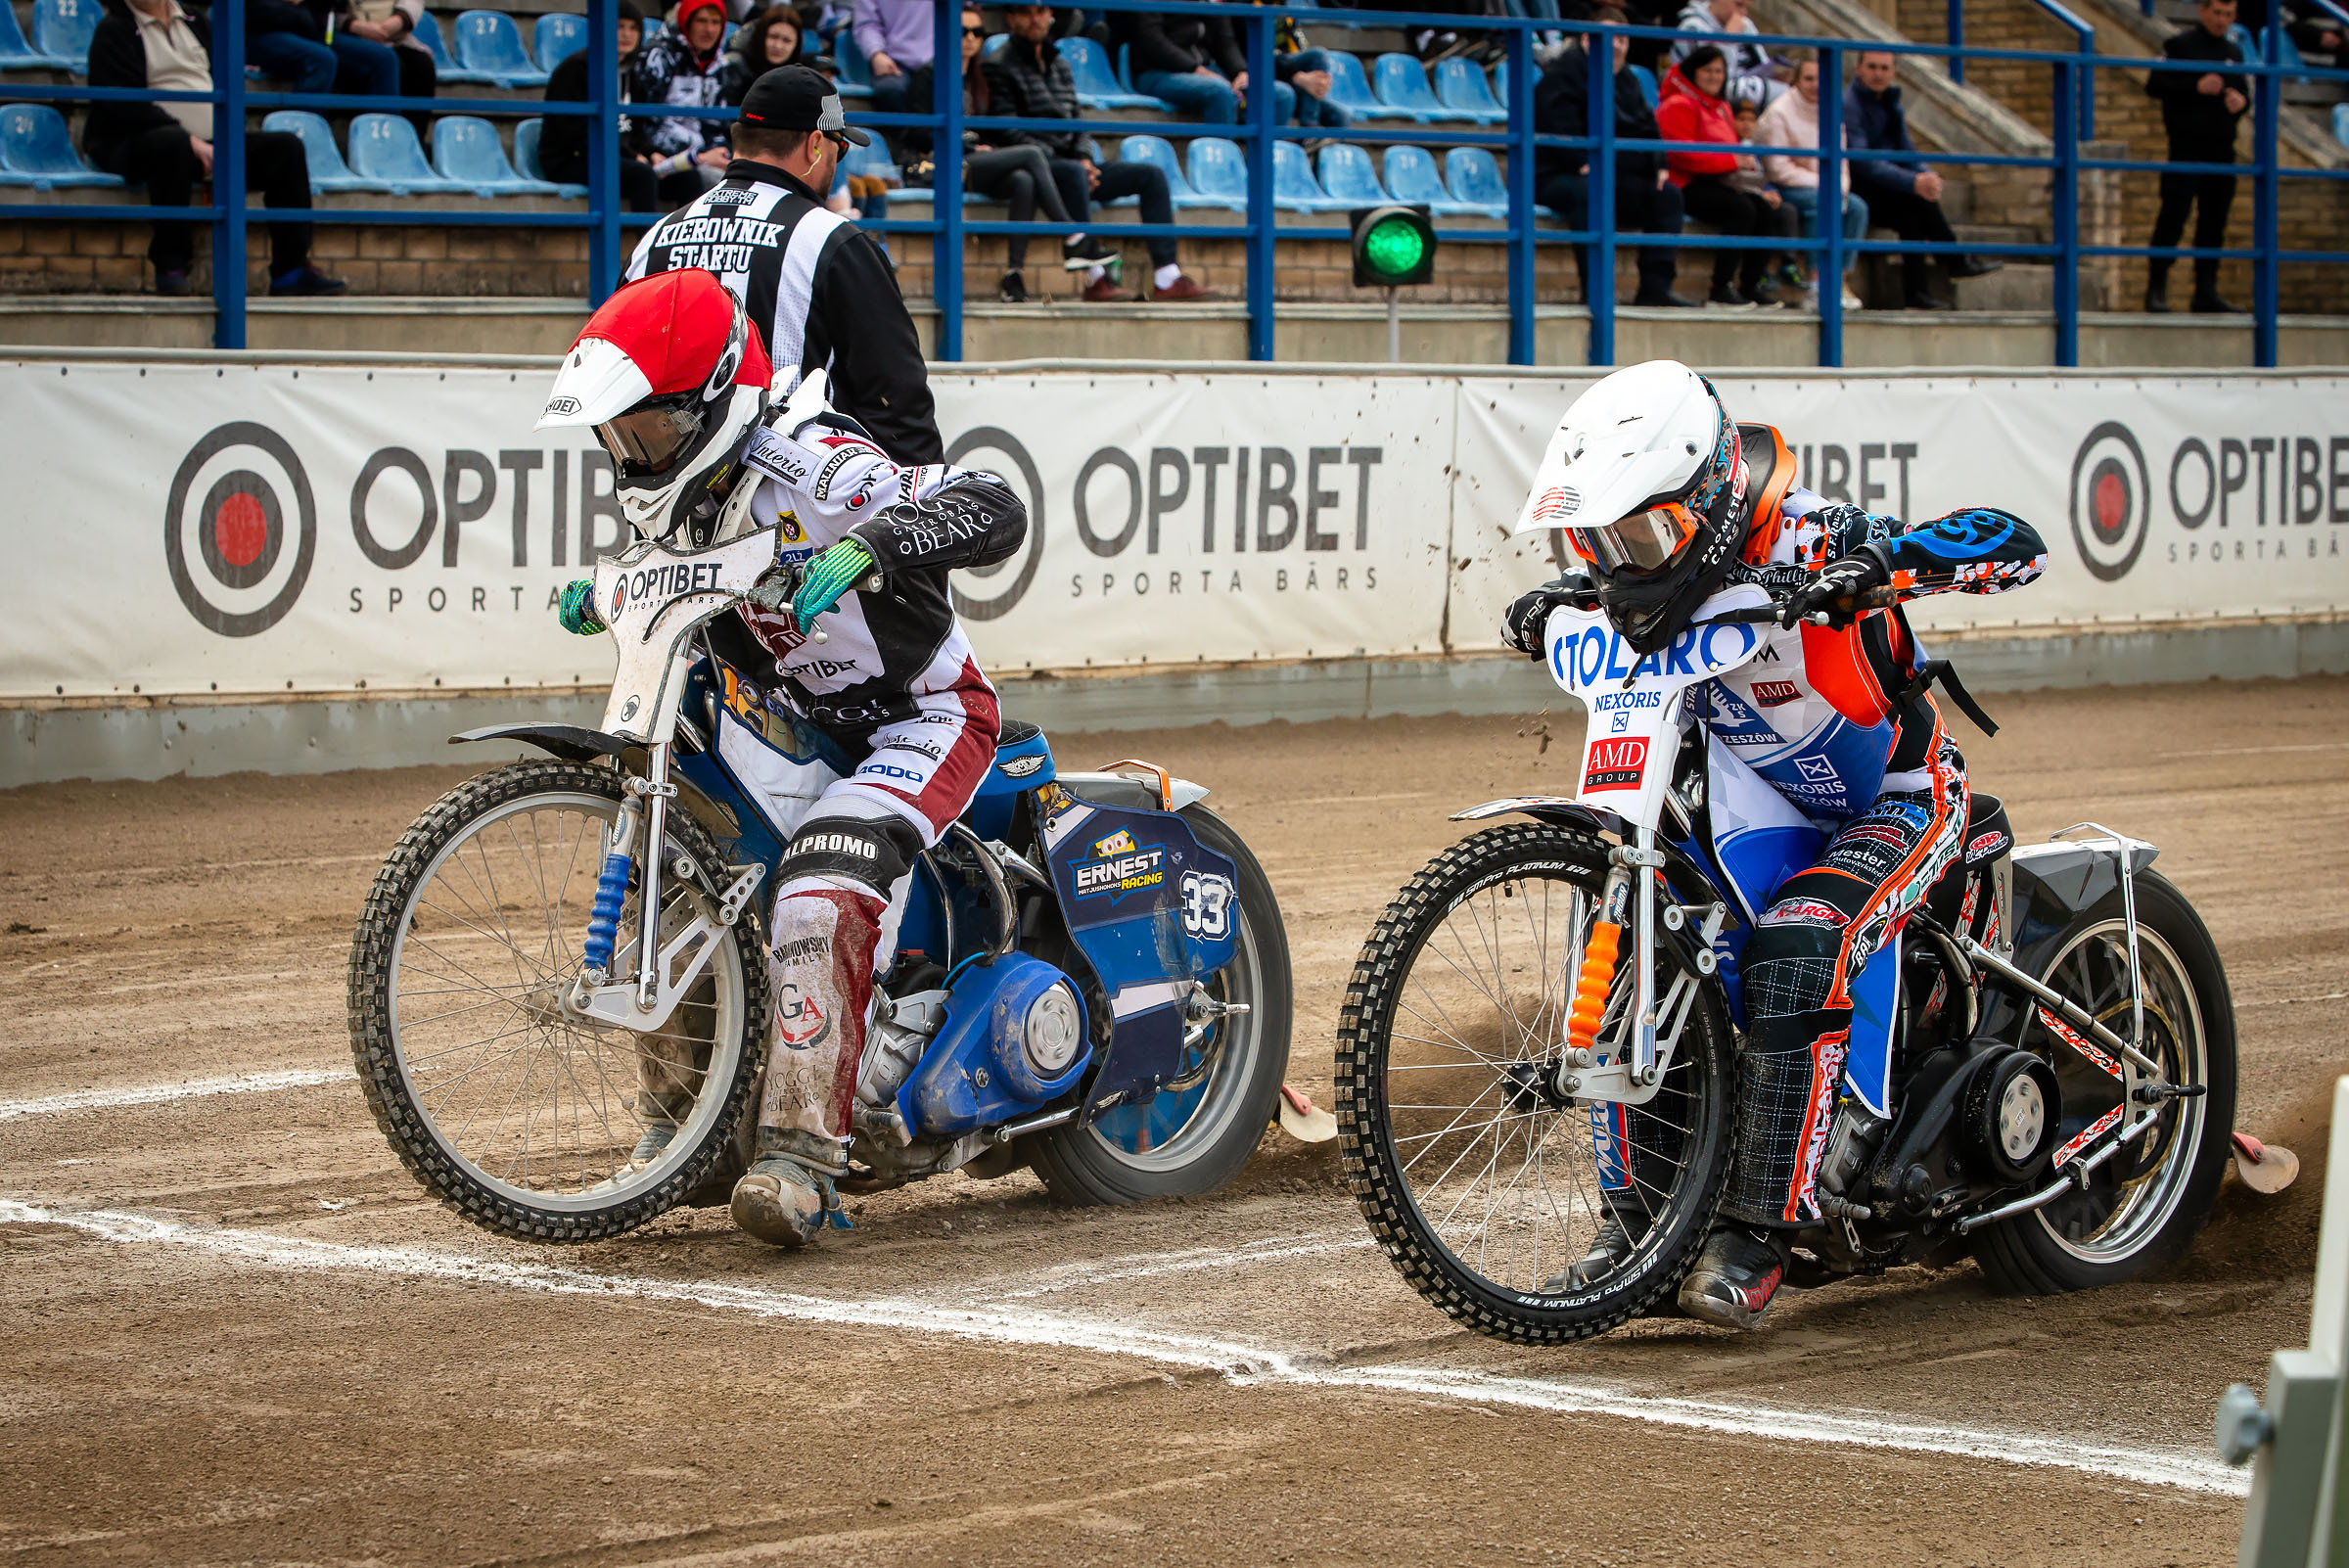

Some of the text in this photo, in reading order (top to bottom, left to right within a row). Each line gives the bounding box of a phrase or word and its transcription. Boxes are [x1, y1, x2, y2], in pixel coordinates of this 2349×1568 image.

[476, 17, 497, 34] 27
[655, 217, 785, 249] KIEROWNIK
[668, 245, 753, 273] STARTU
[750, 432, 809, 478] Interio
[2169, 436, 2349, 529] OPTIBE
[350, 446, 630, 570] OPTIB
[1073, 445, 1383, 558] OPTIBET
[912, 514, 989, 556] BEAR
[1701, 500, 1739, 564] PROMET
[2167, 530, 2340, 563] SPORTA BĀ
[630, 563, 722, 601] OPTIBET
[1071, 562, 1378, 598] SPORTA BĀRS
[1594, 691, 1661, 714] NEXORIS
[1757, 683, 1795, 698] AMD
[1589, 742, 1645, 772] AMD
[1588, 772, 1637, 785] GROUP
[1077, 851, 1163, 888] ERNEST
[1121, 872, 1163, 890] RACING
[1506, 861, 1566, 876] PLATINUM
[1180, 871, 1235, 938] 33
[1773, 905, 1850, 927] KARGER
[1543, 1291, 1601, 1308] PLATINUM
